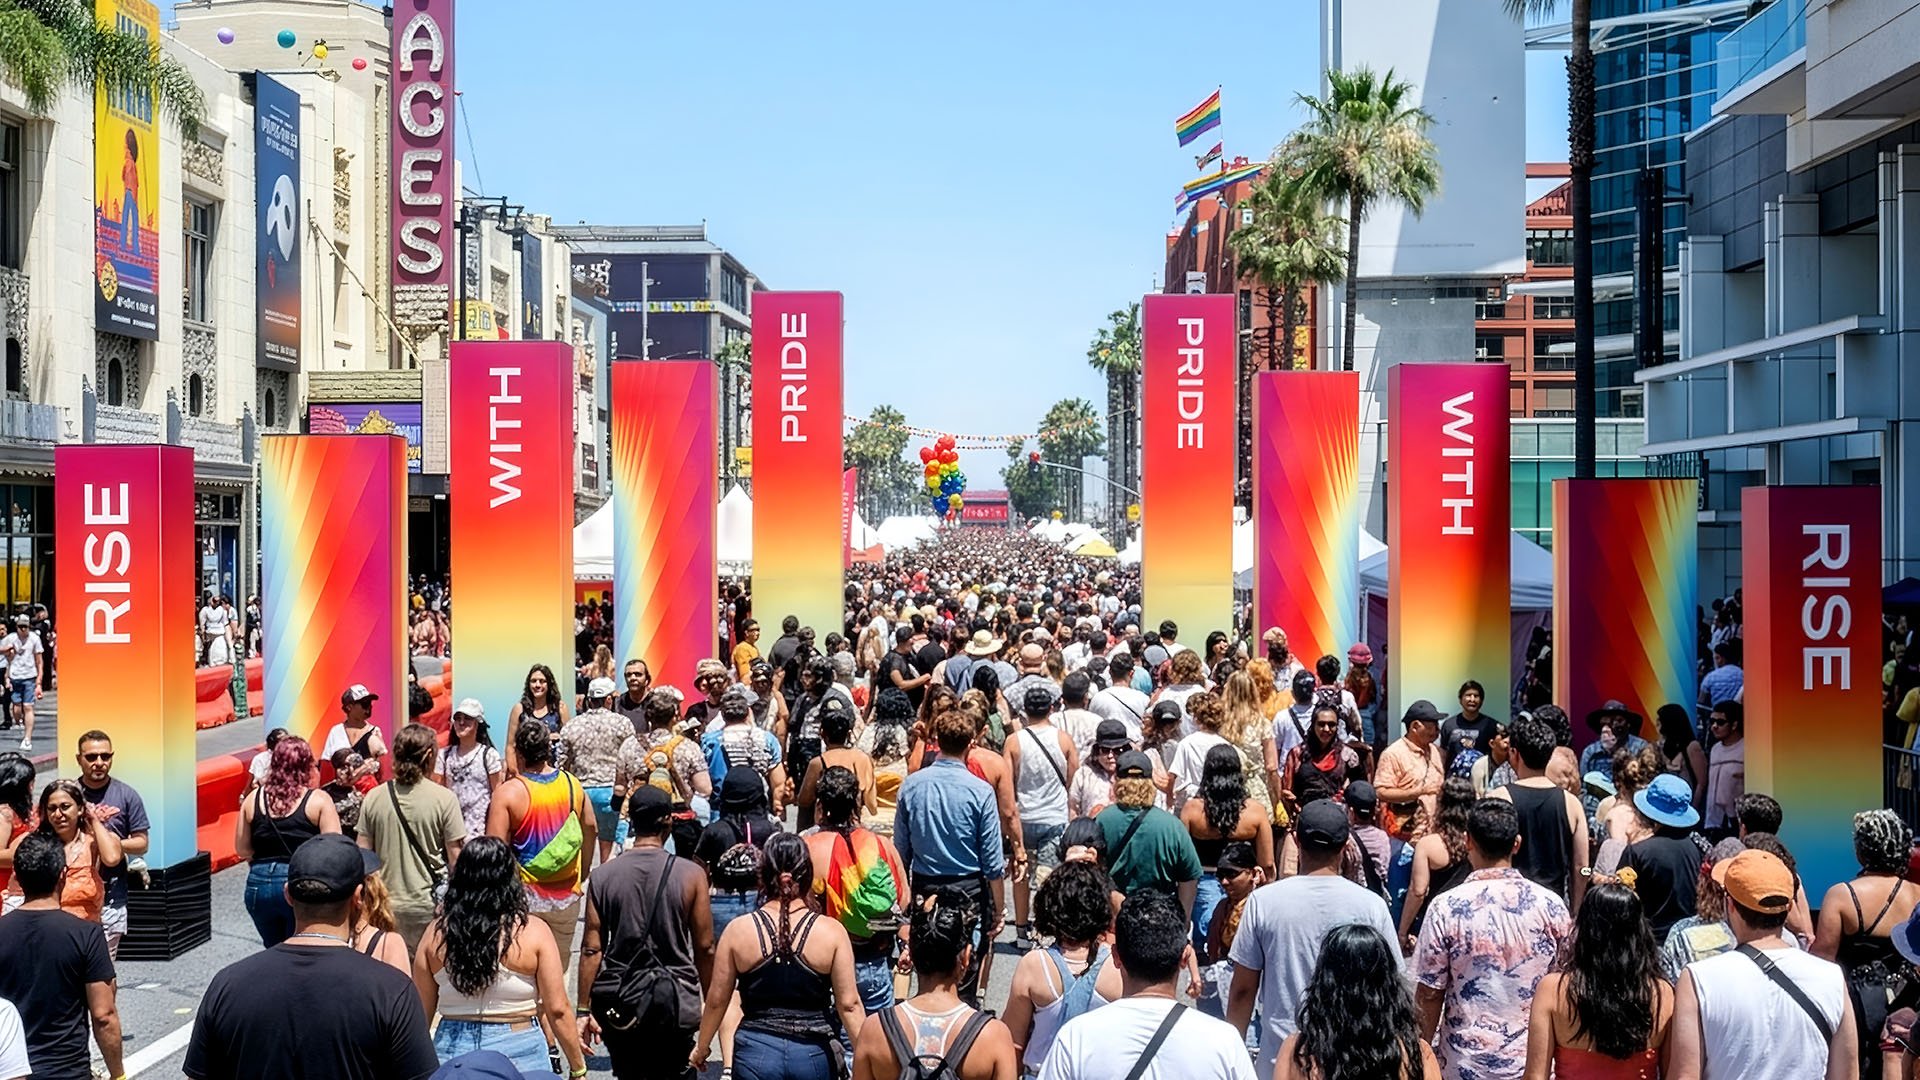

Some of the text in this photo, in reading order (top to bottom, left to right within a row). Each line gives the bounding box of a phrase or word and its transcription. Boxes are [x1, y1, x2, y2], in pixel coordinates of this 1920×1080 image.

[489, 366, 522, 509] WITH
[781, 312, 808, 442] PRIDE
[1177, 317, 1204, 449] PRIDE
[1441, 391, 1474, 535] WITH
[83, 482, 131, 645] RISE
[1802, 524, 1852, 691] RISE
